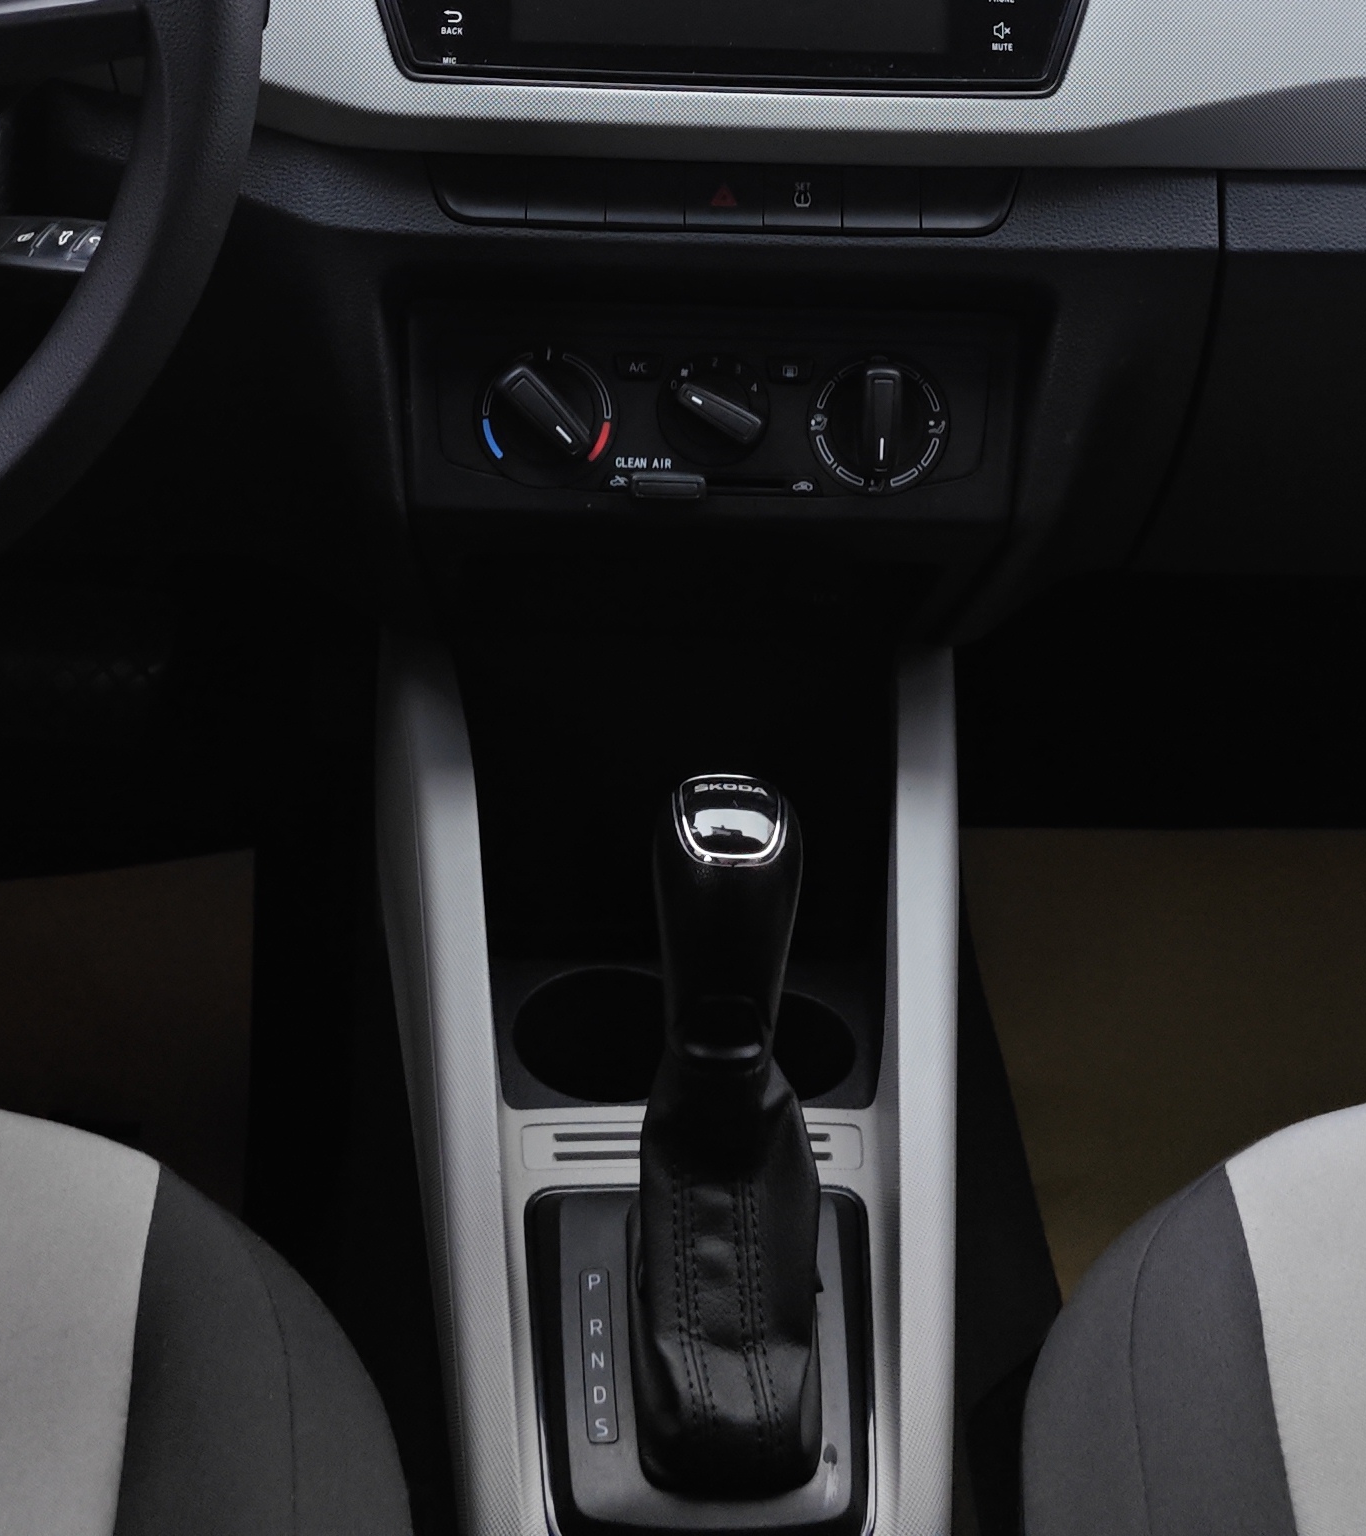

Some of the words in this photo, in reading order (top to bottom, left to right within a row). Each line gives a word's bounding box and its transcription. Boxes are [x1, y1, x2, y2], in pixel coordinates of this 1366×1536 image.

[440, 27, 463, 36] BACK
[991, 43, 1013, 51] MUTE
[615, 457, 647, 468] CLEAN
[652, 458, 672, 469] AIR
[588, 1274, 601, 1291] P
[590, 1319, 603, 1336] R
[591, 1351, 604, 1369] N
[593, 1385, 607, 1404] D
[595, 1417, 609, 1437] S
